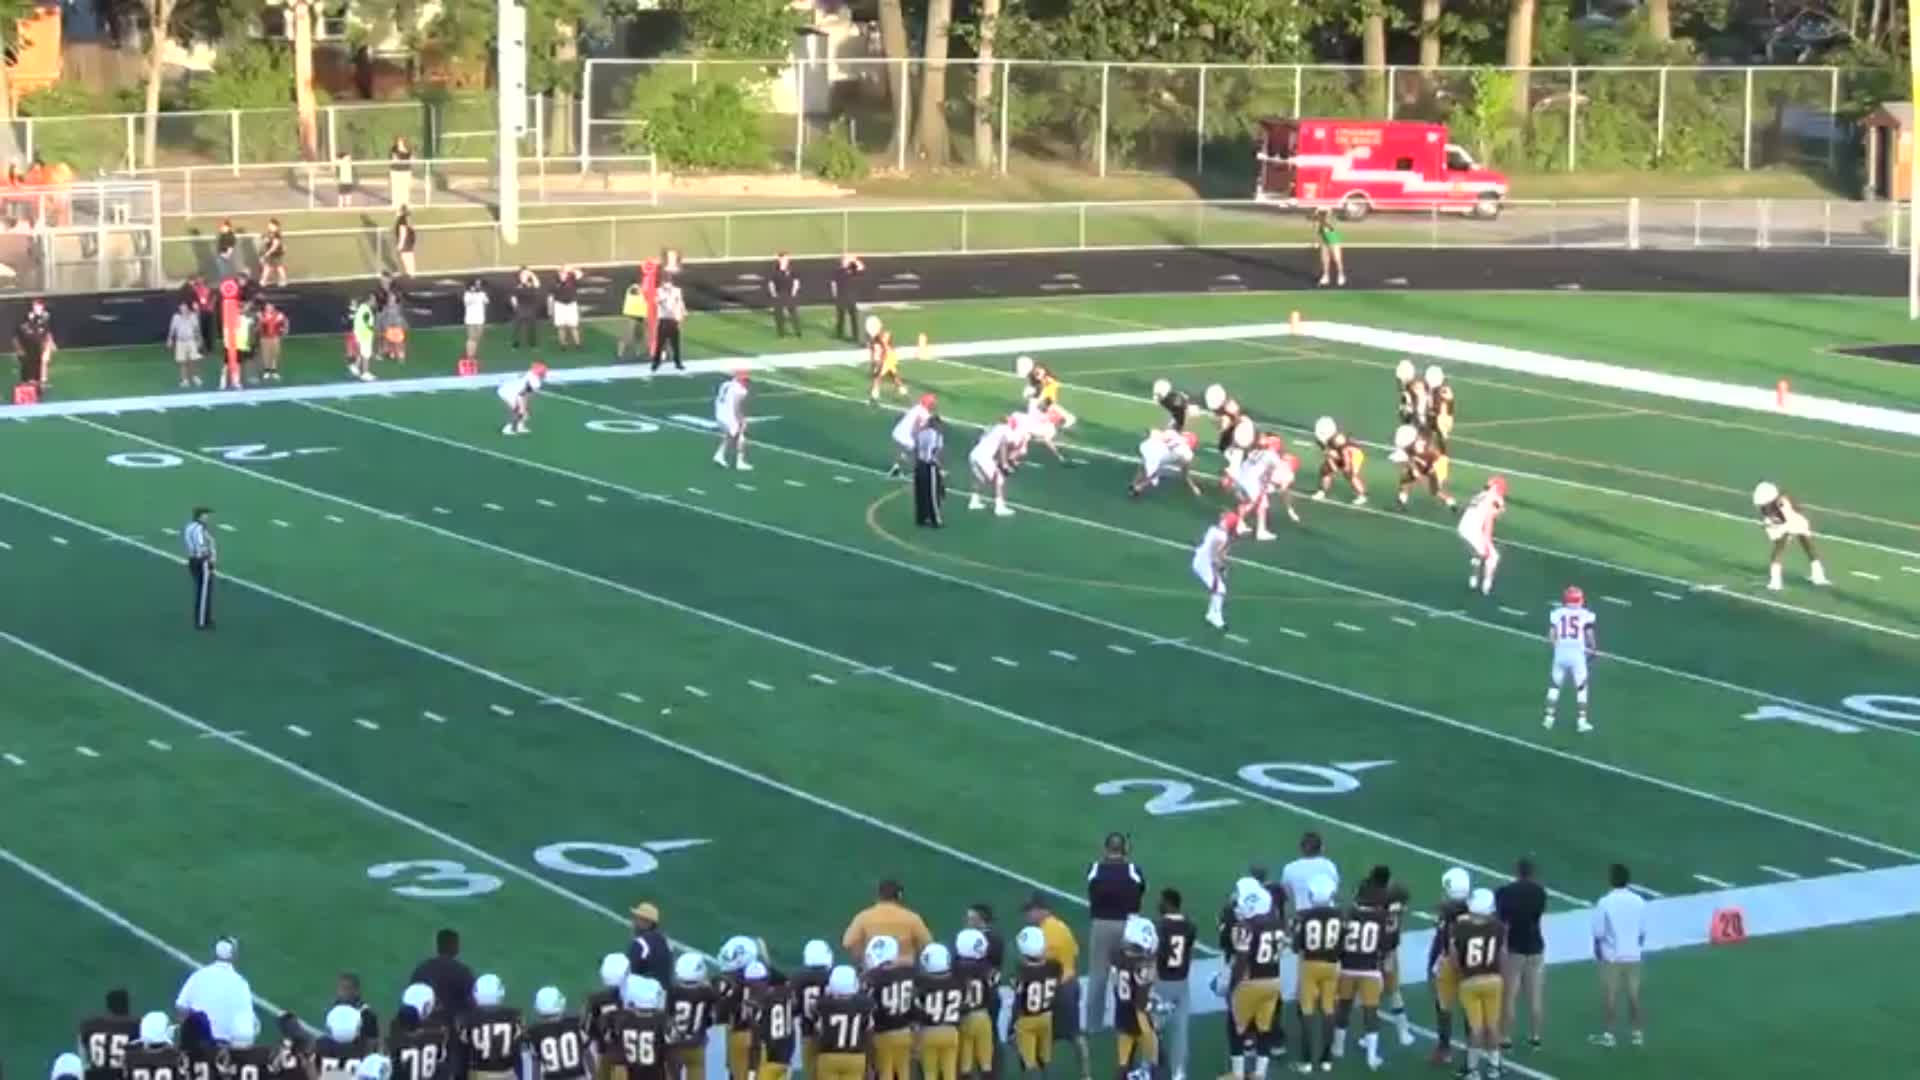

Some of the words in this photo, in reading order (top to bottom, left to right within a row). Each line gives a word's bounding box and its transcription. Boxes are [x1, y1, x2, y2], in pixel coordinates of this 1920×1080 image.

[1560, 616, 1579, 639] 15
[1305, 918, 1340, 950] 88
[1345, 921, 1379, 953] 20
[1719, 911, 1743, 937] 20
[1168, 935, 1185, 967] 3
[1466, 935, 1496, 968] 61
[1119, 969, 1131, 1001] 6
[676, 1001, 705, 1034] 21
[925, 989, 962, 1022] 42
[472, 1023, 512, 1059] 47
[623, 1029, 655, 1066] 56
[830, 1014, 860, 1048] 71
[89, 1033, 129, 1067] 65
[401, 1044, 437, 1080] 78
[540, 1032, 579, 1072] 90
